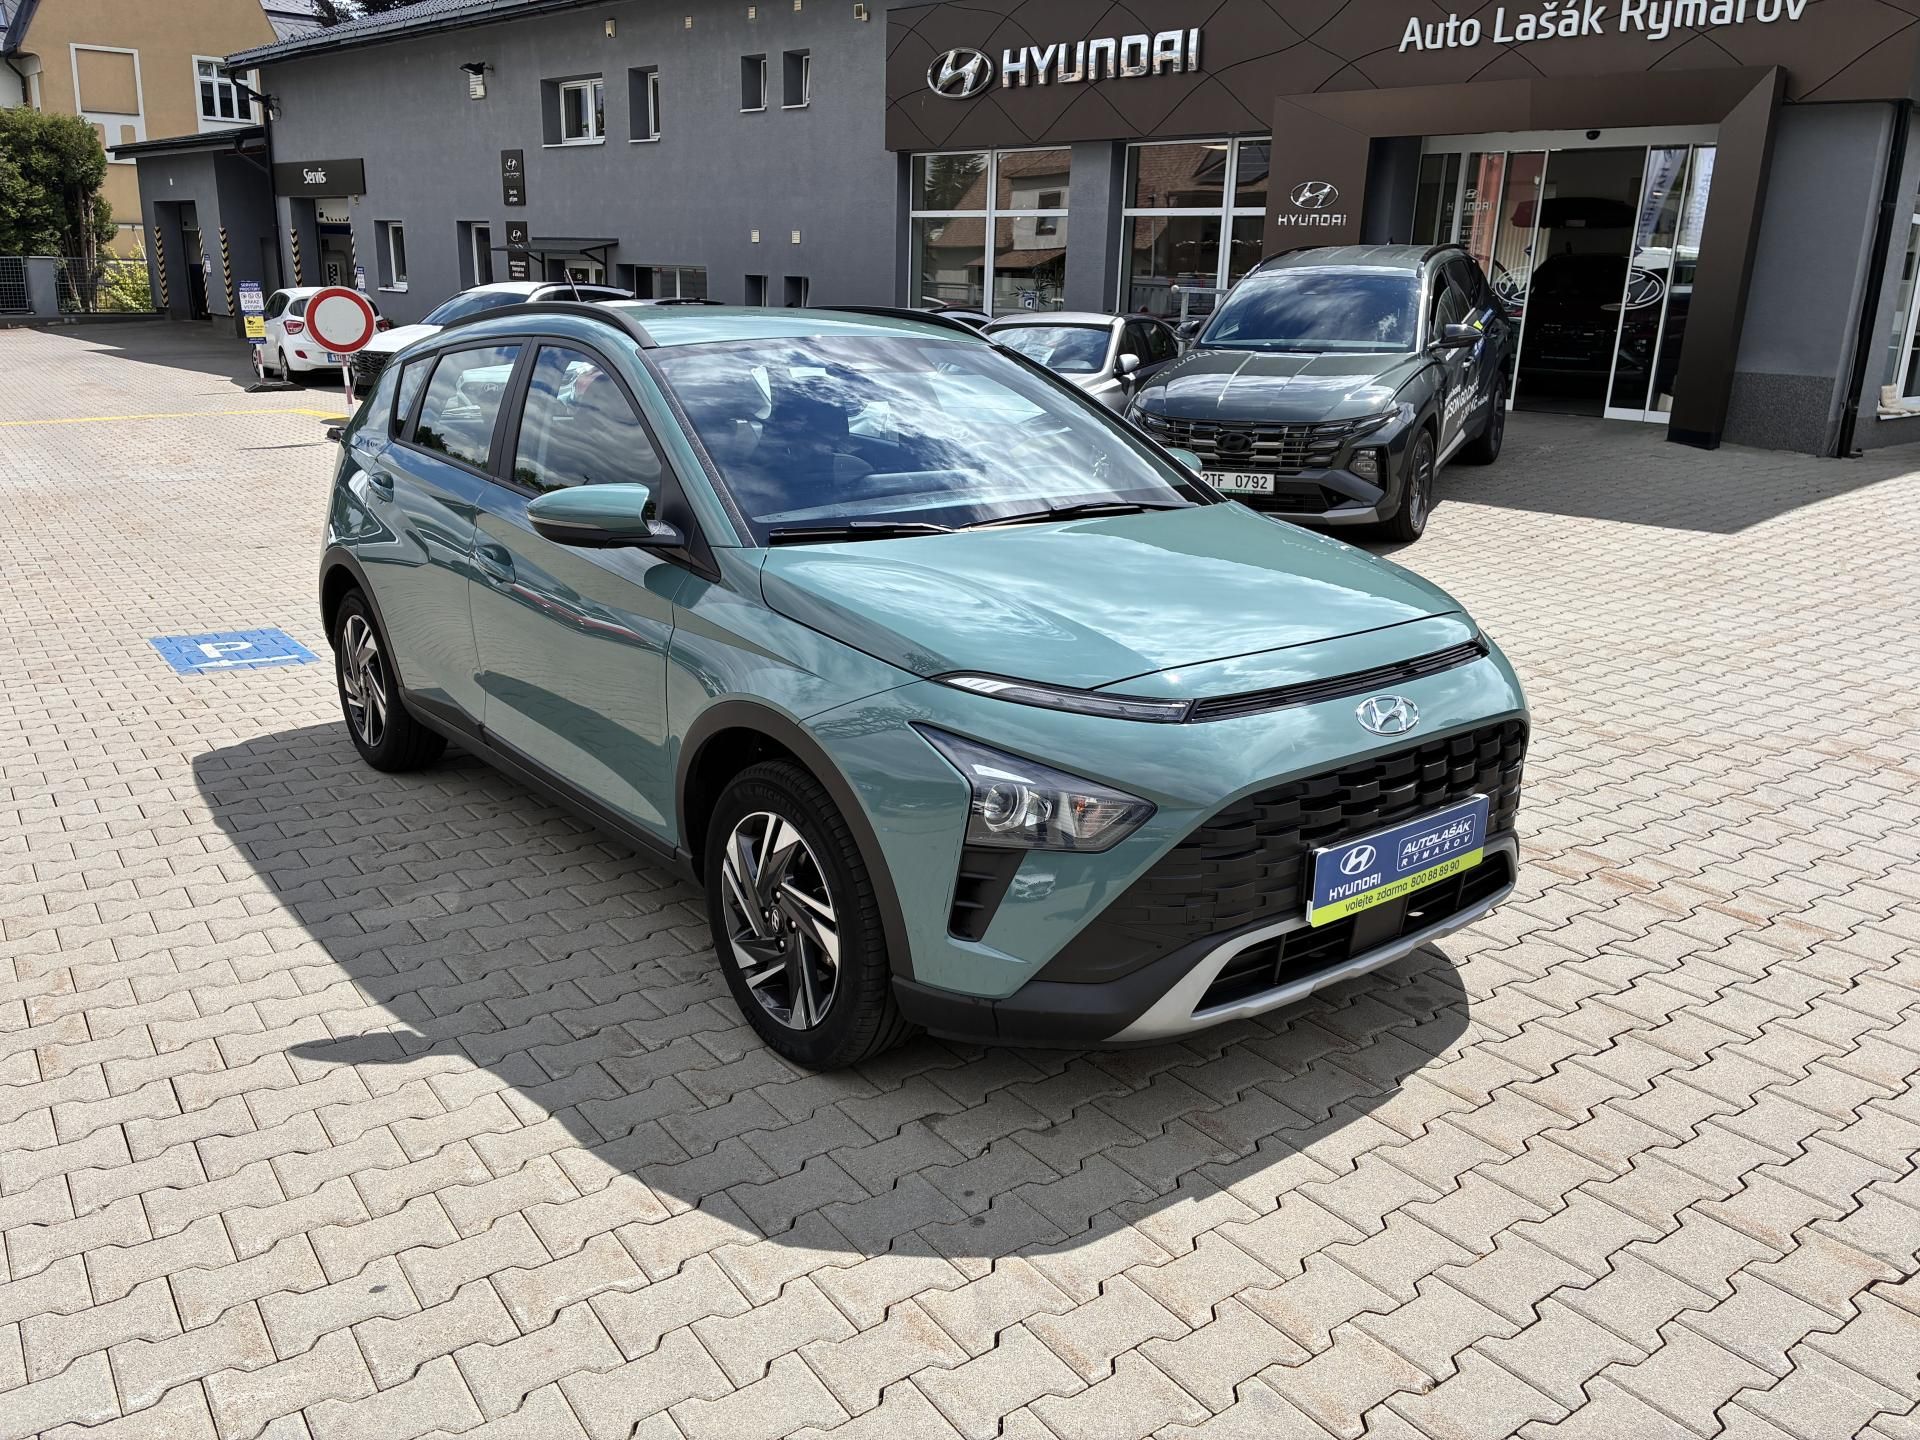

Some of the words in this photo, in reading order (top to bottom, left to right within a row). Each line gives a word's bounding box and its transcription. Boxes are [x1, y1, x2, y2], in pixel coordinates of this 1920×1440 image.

[1398, 13, 1481, 53] Auto
[1493, 0, 1607, 44] Lašák
[1002, 27, 1200, 88] HYUNDAI
[303, 167, 327, 184] Servis
[1277, 214, 1347, 226] HYUNDAI
[1446, 201, 1493, 212] HUNDAI
[1235, 474, 1268, 490] 0792
[1402, 819, 1473, 855] AUTOLAŠÁK
[1329, 872, 1382, 901] HYUNDAI
[1345, 894, 1374, 913] volejte
[1376, 883, 1408, 901] zdarma
[1410, 874, 1427, 888] 800
[1427, 870, 1438, 882] 88
[1438, 865, 1449, 879] 89
[1449, 859, 1460, 874] 90
